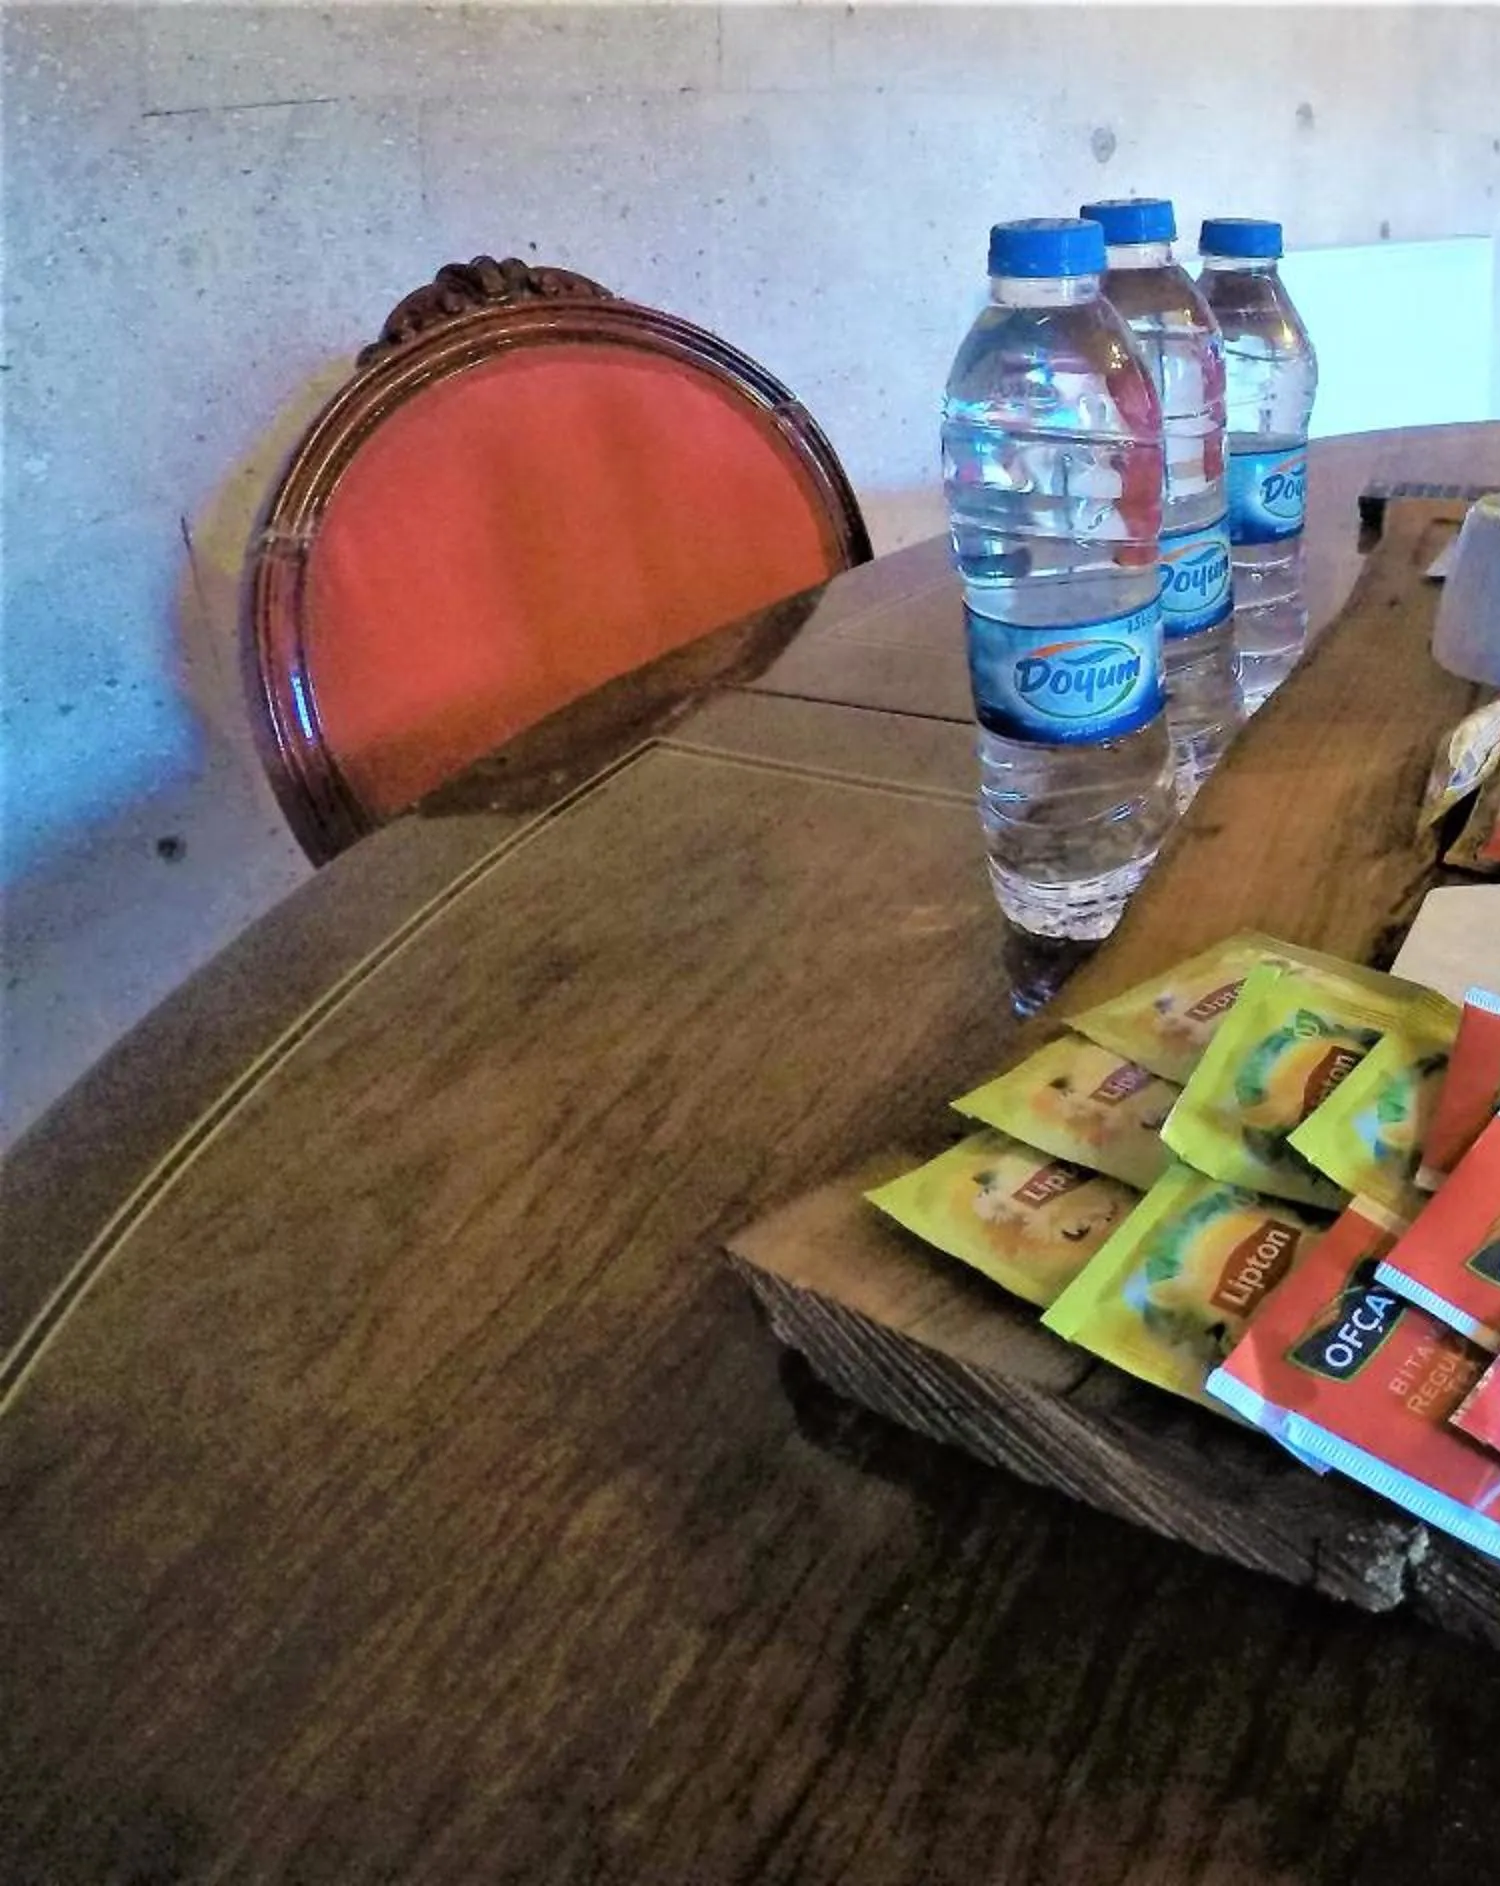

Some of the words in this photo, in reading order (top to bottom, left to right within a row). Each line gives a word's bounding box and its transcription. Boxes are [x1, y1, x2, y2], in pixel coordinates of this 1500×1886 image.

[1015, 655, 1141, 701] Doyum
[1219, 1228, 1291, 1307] Lipton
[1325, 1284, 1398, 1368] OFÇA
